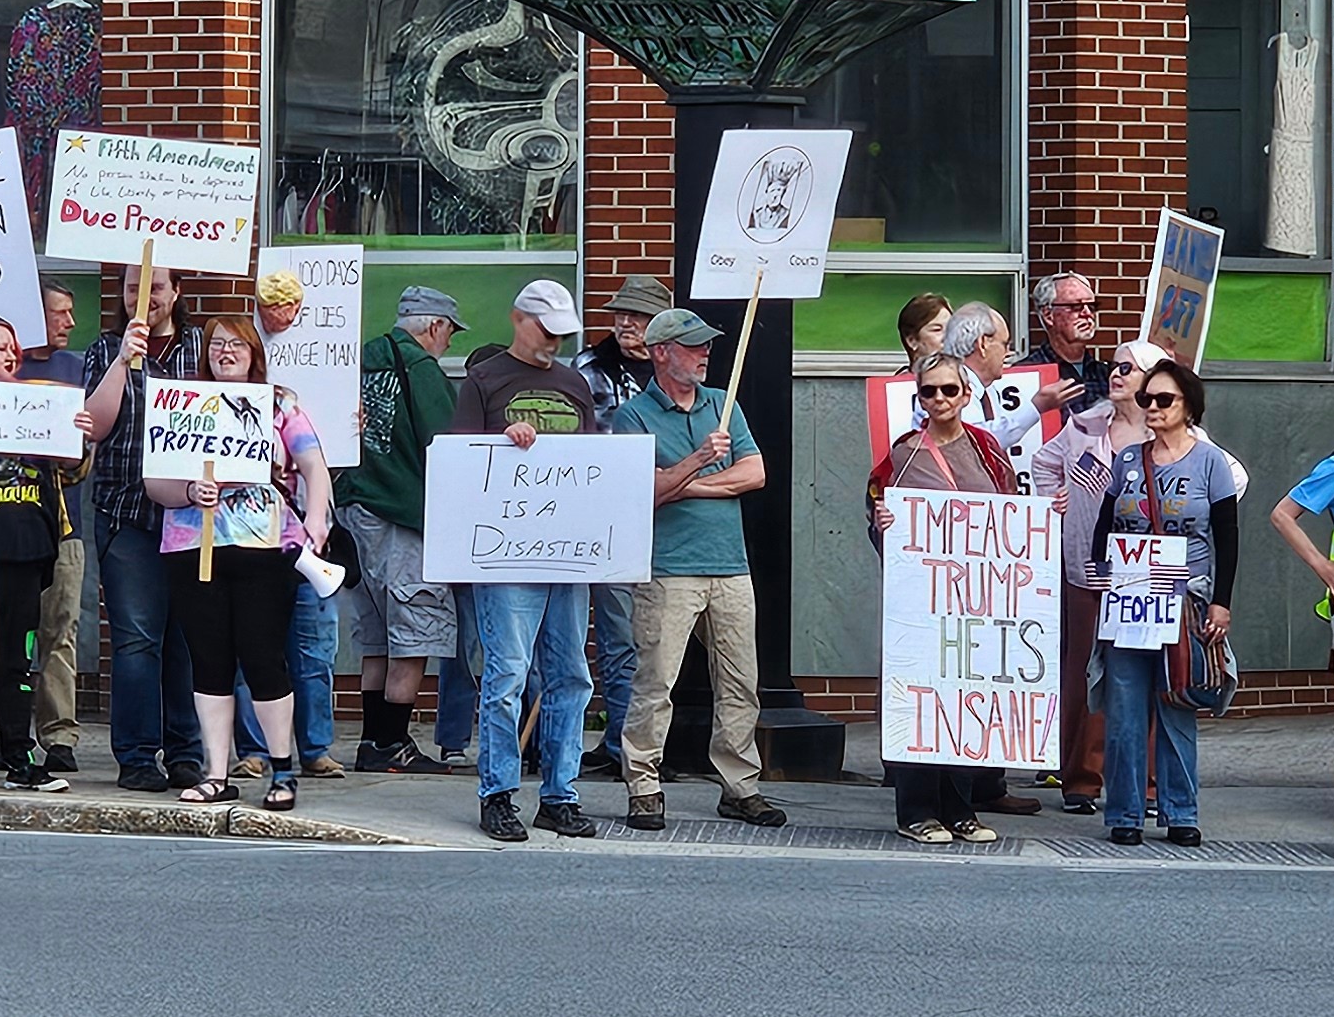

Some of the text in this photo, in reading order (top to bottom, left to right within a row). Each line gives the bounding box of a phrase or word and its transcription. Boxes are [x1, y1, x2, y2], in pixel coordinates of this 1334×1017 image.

[60, 198, 116, 229] Due
[298, 259, 359, 287] 100 DAYS
[314, 305, 346, 327] LIES
[269, 341, 357, 367] RANGE MAN
[154, 388, 221, 414] NOT A
[169, 411, 216, 432] PAID
[501, 500, 557, 519] IS A
[902, 496, 1051, 560] IMPEACH
[1116, 538, 1161, 566] WE
[1105, 591, 1176, 623] PEOPLE
[940, 616, 1046, 684] HE IS
[907, 685, 1058, 763] INSANE!
